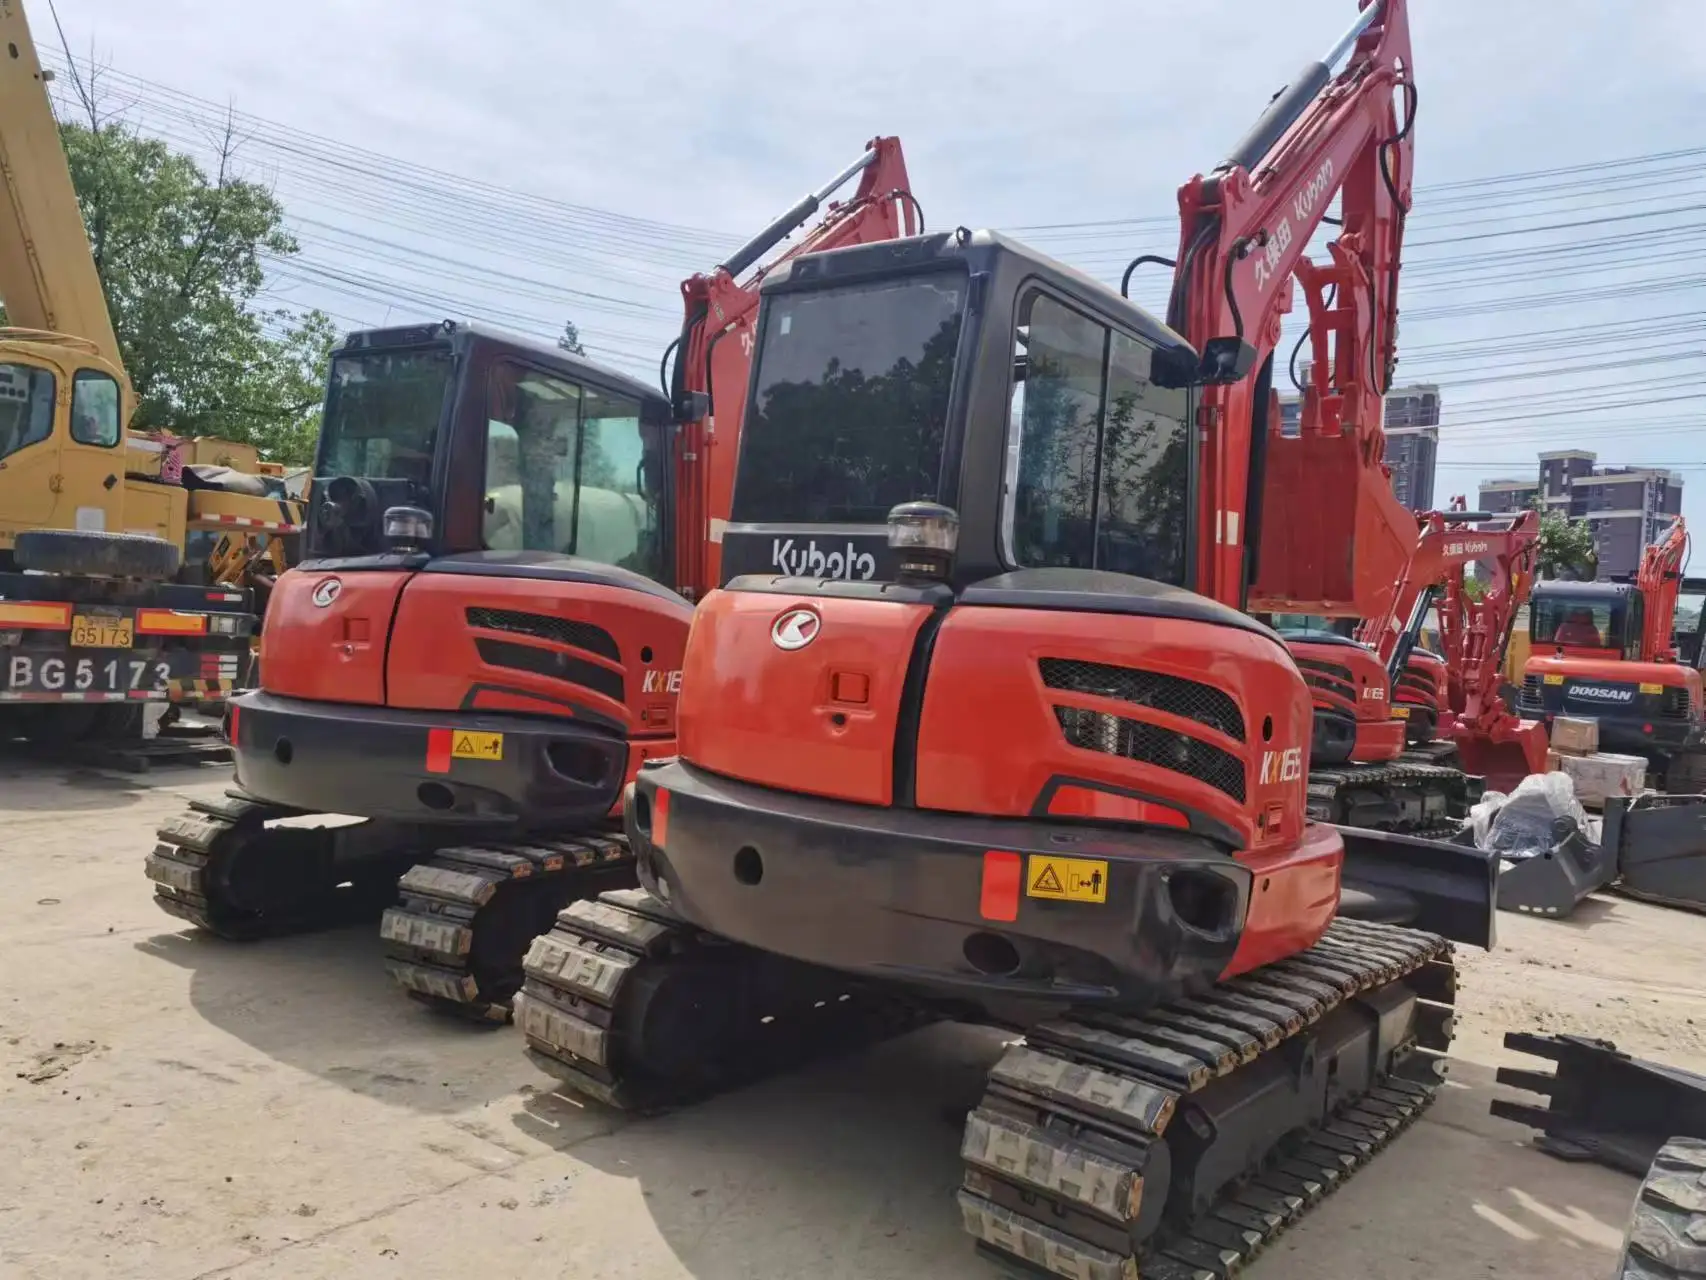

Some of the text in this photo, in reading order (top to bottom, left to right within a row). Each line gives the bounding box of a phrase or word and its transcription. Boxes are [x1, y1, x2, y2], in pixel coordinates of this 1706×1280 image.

[772, 538, 876, 580] Kubota
[75, 627, 130, 645] G5173
[1568, 685, 1633, 701] DOOSAN
